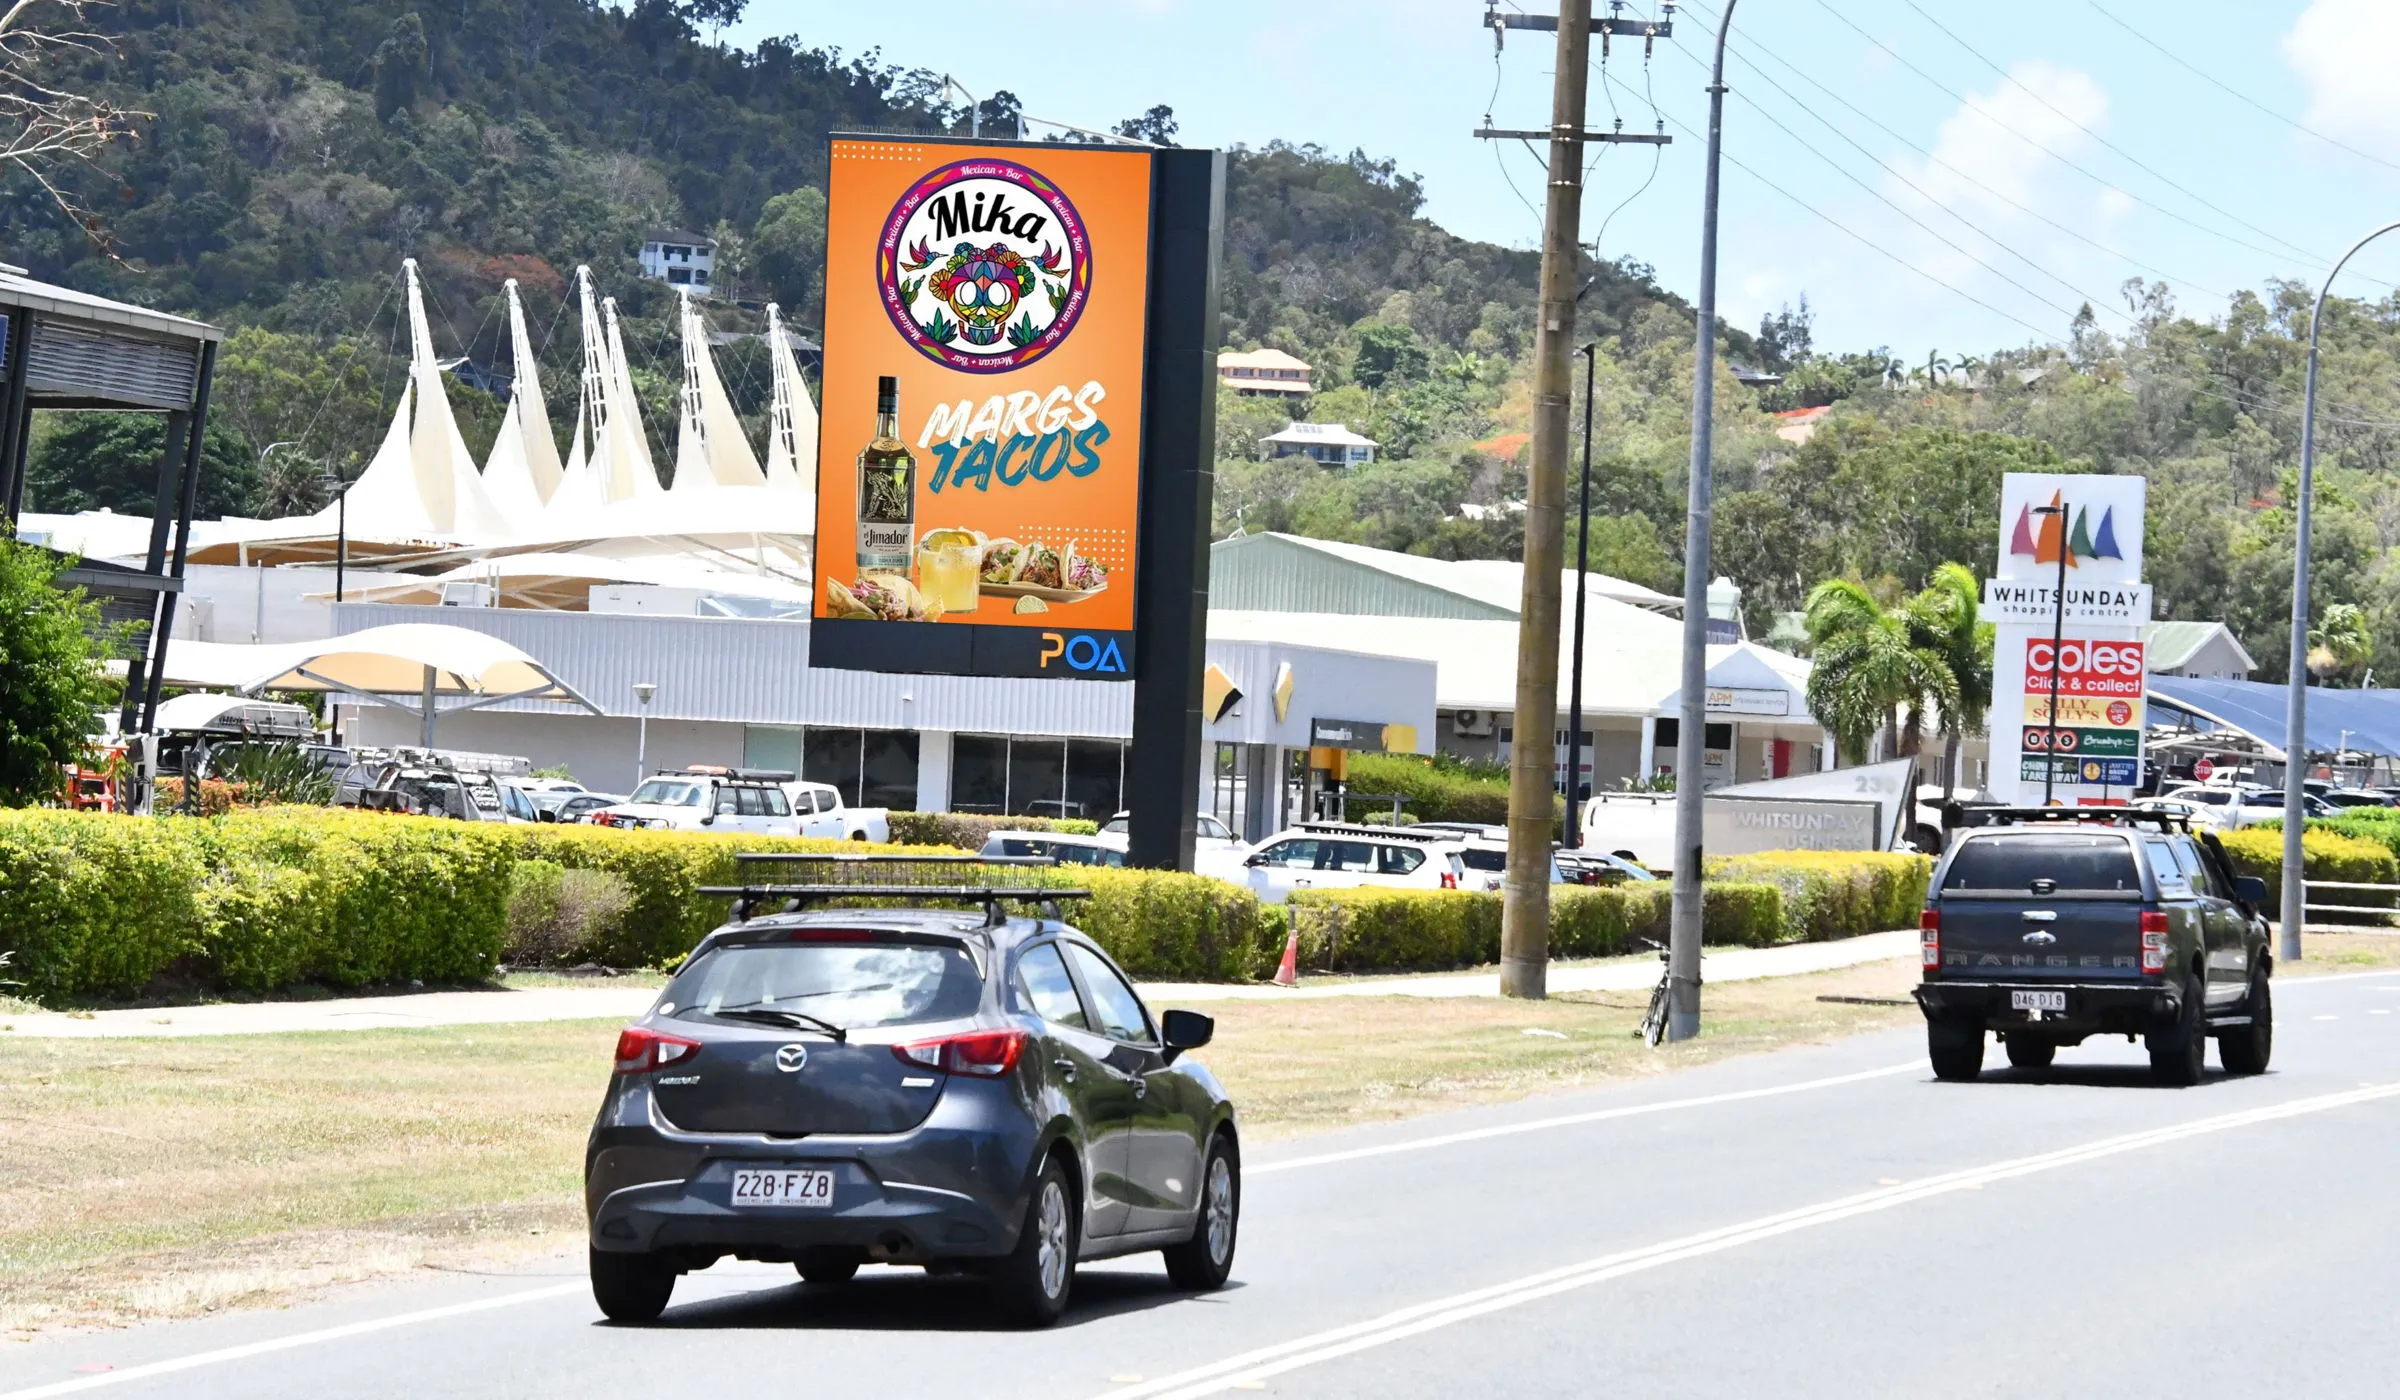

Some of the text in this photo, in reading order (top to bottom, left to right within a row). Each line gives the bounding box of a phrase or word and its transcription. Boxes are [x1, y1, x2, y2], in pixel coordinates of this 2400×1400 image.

[960, 166, 1023, 180] Mexican Bar
[885, 193, 920, 250] Mexican Bar
[928, 190, 1047, 243] Mika
[1052, 195, 1084, 253] Mexican Bar
[887, 285, 922, 341] Mexican Bar
[1045, 289, 1084, 344] Mexican Bar
[952, 354, 1014, 367] Mexican Bar
[916, 380, 1106, 449] MARGS
[928, 419, 1111, 494] TACOS
[865, 528, 908, 548] Jimador
[2003, 606, 2129, 617] shoppig centre
[1040, 632, 1126, 672] POA
[2028, 640, 2142, 675] coles
[2070, 677, 2081, 690] &
[2086, 679, 2141, 693] collect
[2043, 698, 2090, 709] SLLY
[1734, 812, 1864, 832] WHITSUNDAY
[1946, 953, 2136, 968] RANGER
